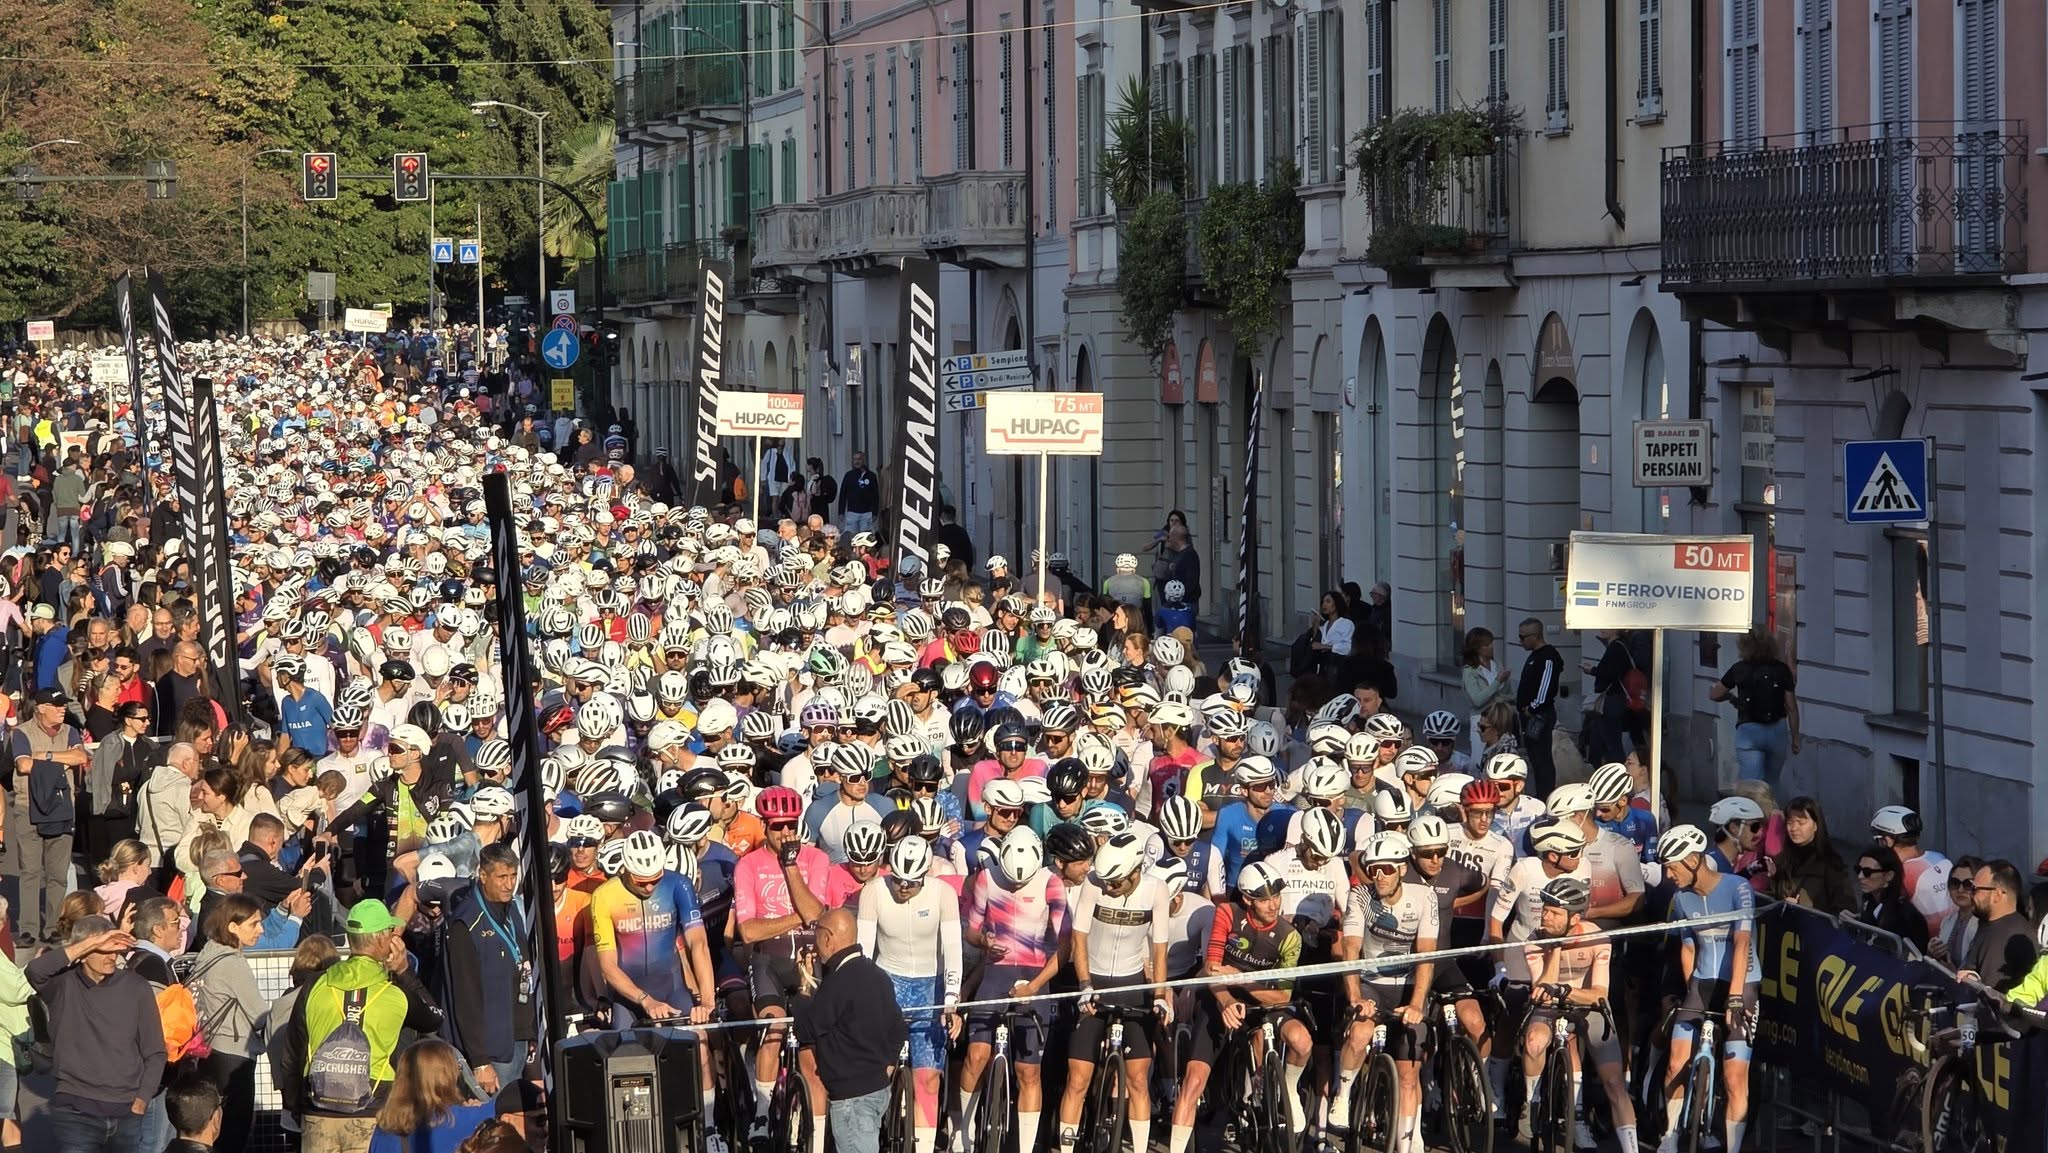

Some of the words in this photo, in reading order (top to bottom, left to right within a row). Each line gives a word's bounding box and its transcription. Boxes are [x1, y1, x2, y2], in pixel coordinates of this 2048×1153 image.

[960, 358, 969, 368] P
[694, 269, 724, 491] SPECIALIZED
[962, 376, 971, 386] P
[964, 395, 973, 406] P
[1056, 397, 1076, 412] 75
[1079, 402, 1095, 412] MT
[735, 411, 786, 426] HUPAC
[1011, 418, 1080, 435] HUPAC
[1646, 442, 1697, 457] TAPPETI
[1642, 462, 1702, 477] PERSIANI
[1684, 545, 1714, 568] 50
[1717, 552, 1745, 569] MT
[1606, 581, 1745, 602] FERROVIENORD
[288, 720, 312, 730] TALIA
